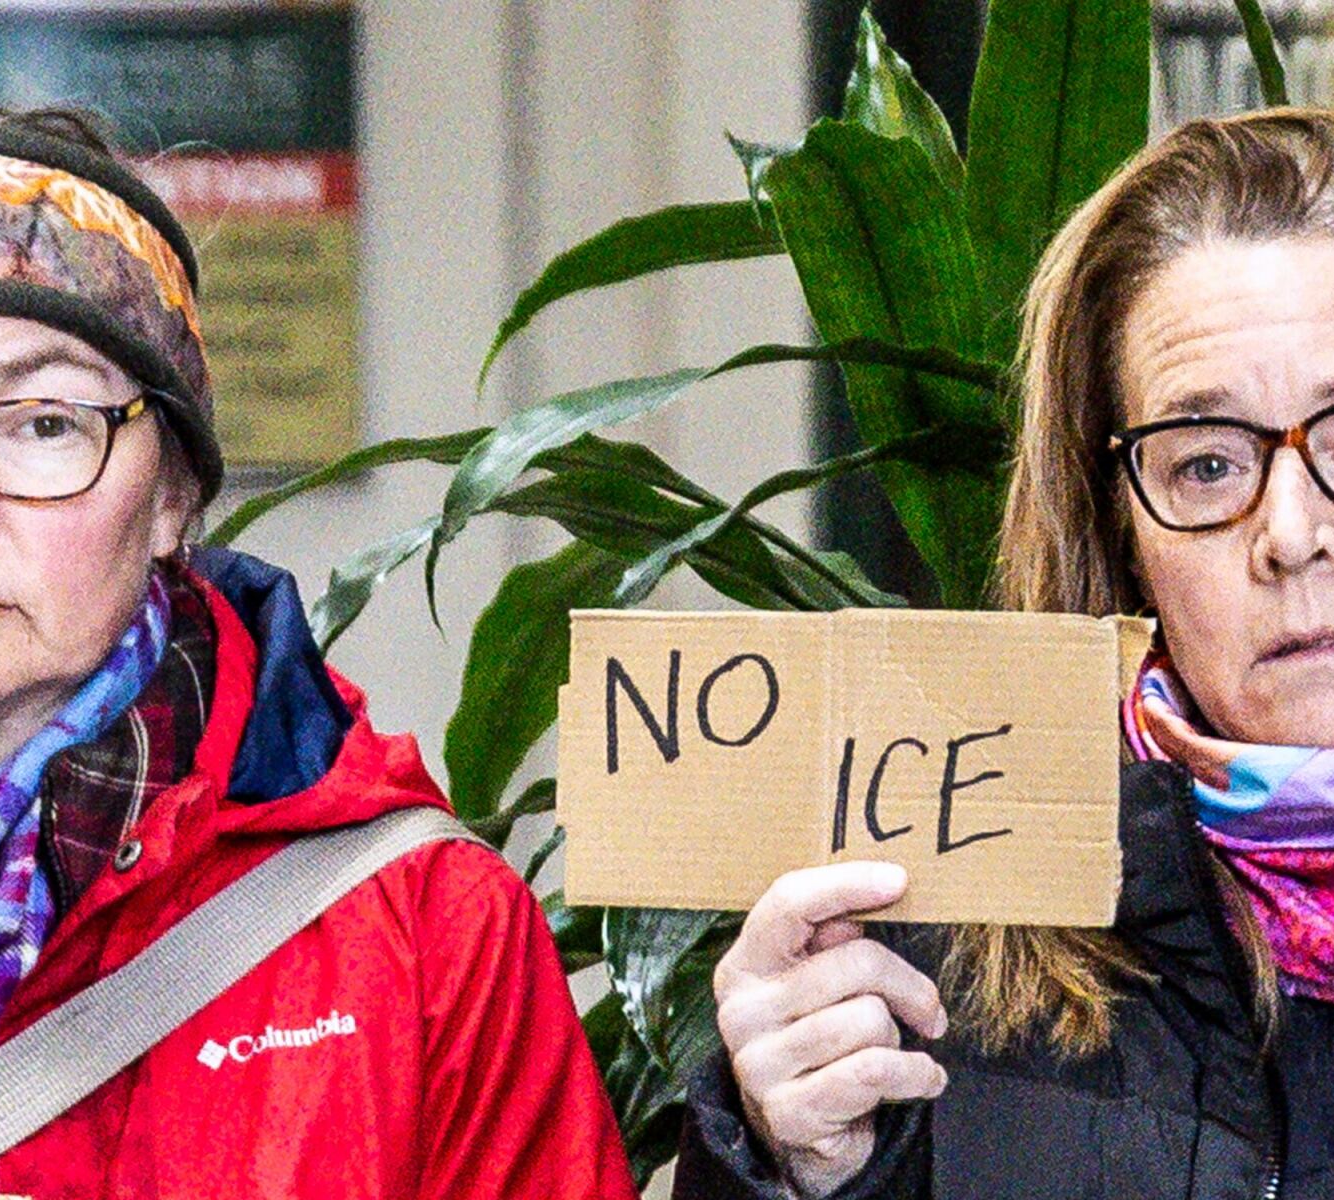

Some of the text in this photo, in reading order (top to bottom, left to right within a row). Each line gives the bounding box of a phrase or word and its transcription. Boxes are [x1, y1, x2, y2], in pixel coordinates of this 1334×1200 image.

[606, 650, 780, 774] NO
[831, 724, 1013, 855] ICE
[227, 1009, 357, 1063] Columbia
